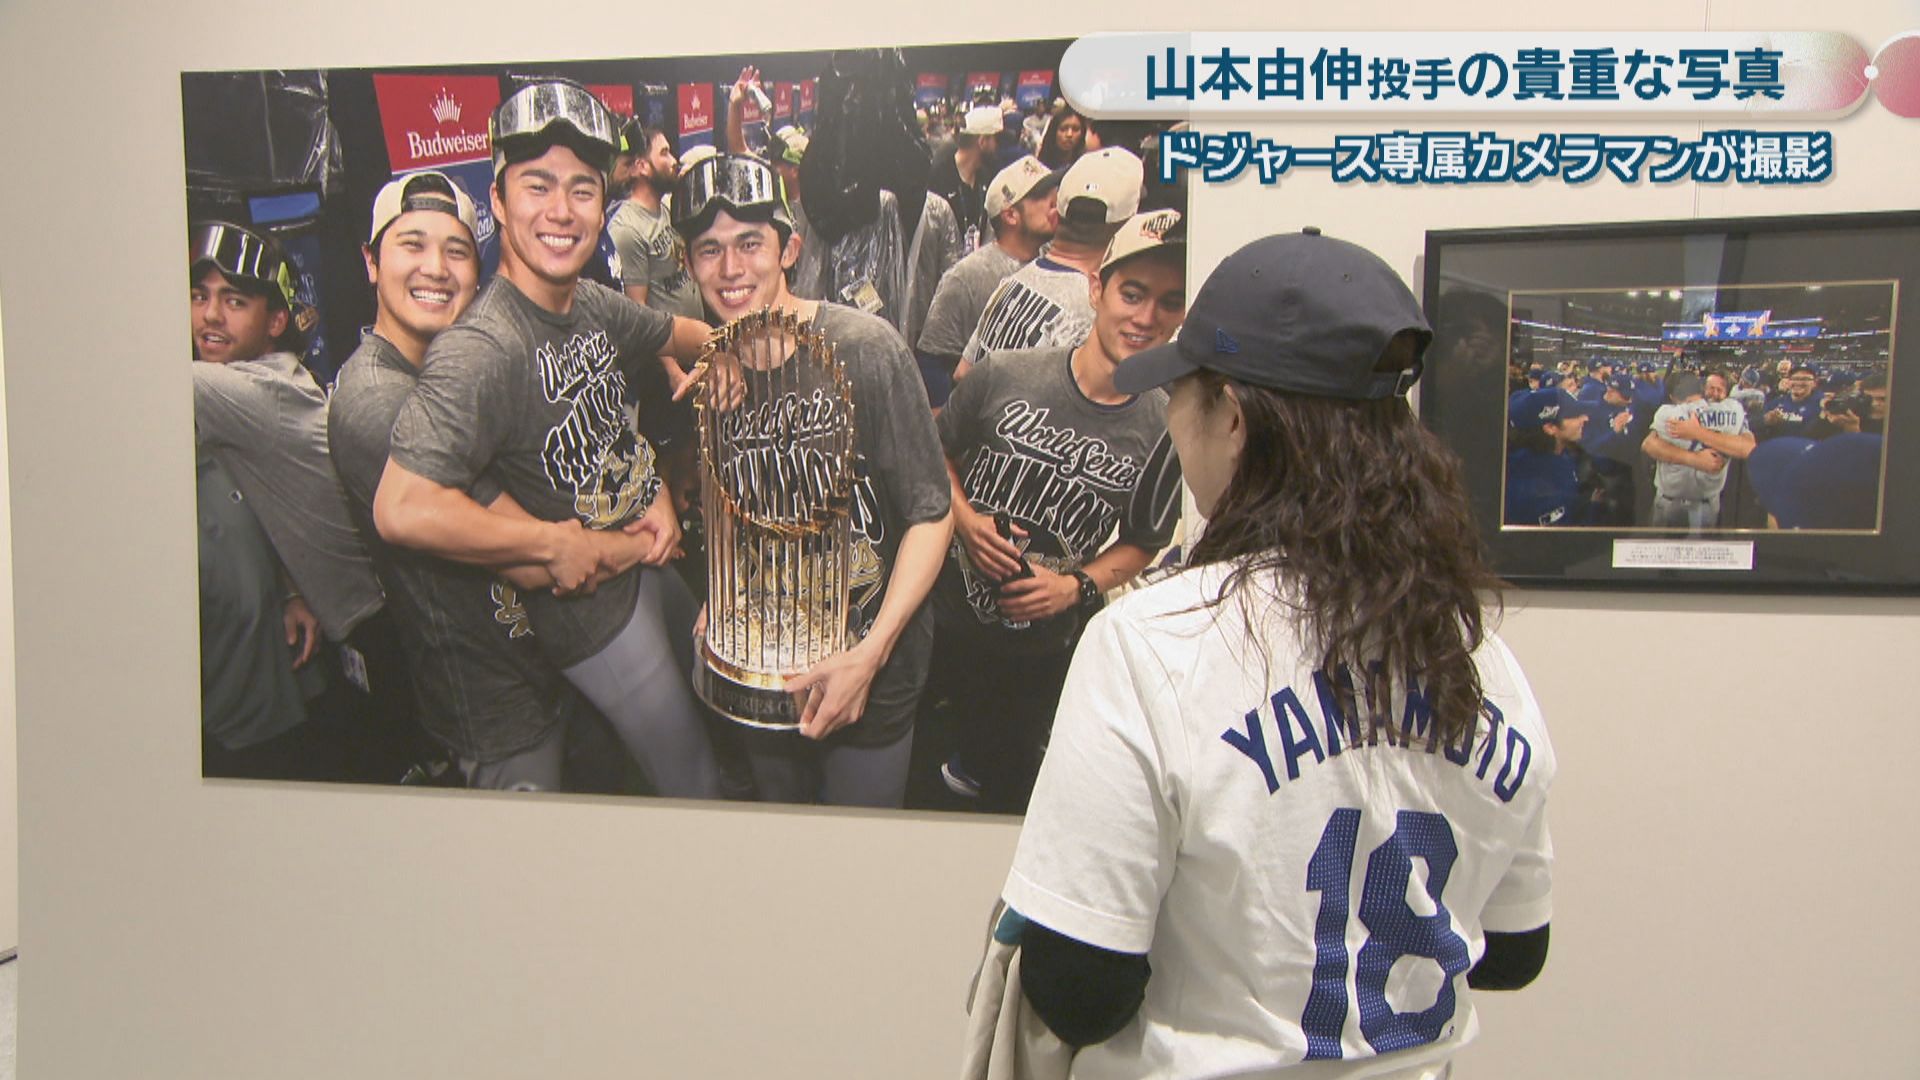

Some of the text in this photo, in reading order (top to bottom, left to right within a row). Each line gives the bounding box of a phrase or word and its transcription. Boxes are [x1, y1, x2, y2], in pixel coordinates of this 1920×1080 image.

[407, 129, 488, 159] Budweiser
[996, 400, 1076, 462] World
[1302, 807, 1471, 1061] 18
